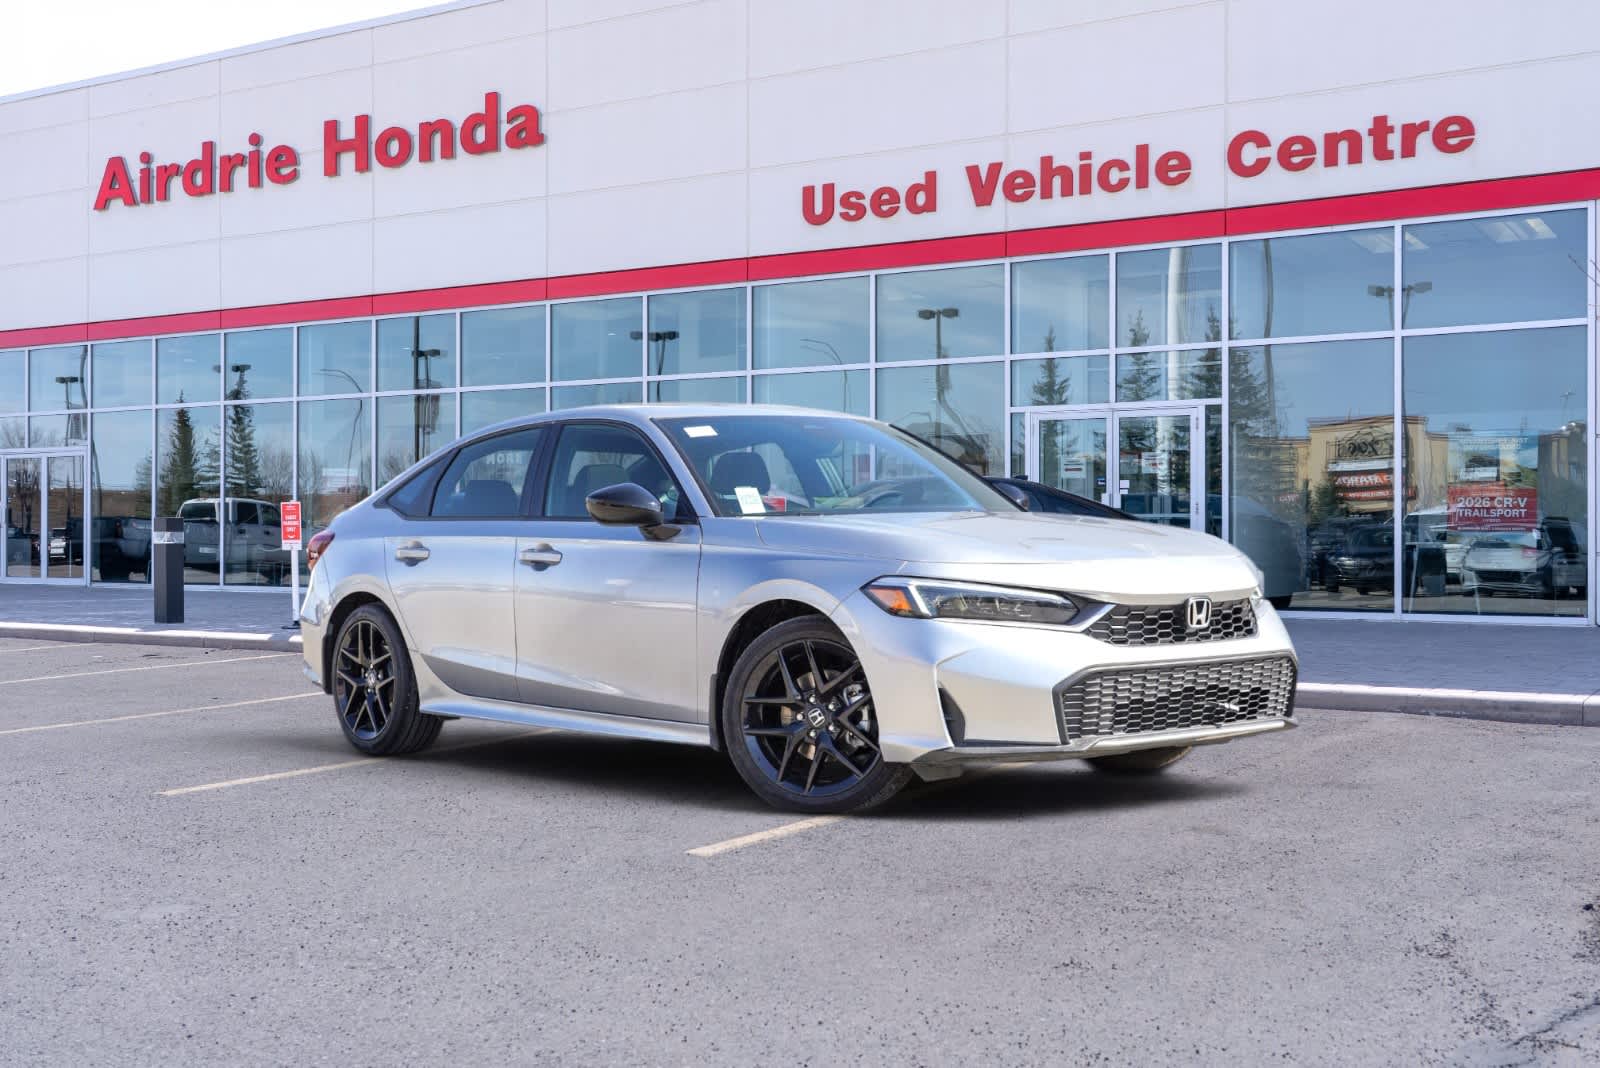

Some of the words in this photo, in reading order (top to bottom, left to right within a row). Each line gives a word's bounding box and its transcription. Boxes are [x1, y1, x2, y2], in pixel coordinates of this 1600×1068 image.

[94, 133, 298, 210] Airdrie
[324, 92, 545, 177] Honda
[802, 171, 937, 226] Used
[966, 144, 1191, 206] Vehicle
[1227, 115, 1475, 178] Centre
[1456, 496, 1490, 508] 2026
[1494, 496, 1528, 508] CR-V
[1458, 508, 1527, 518] TRAILSPORT
